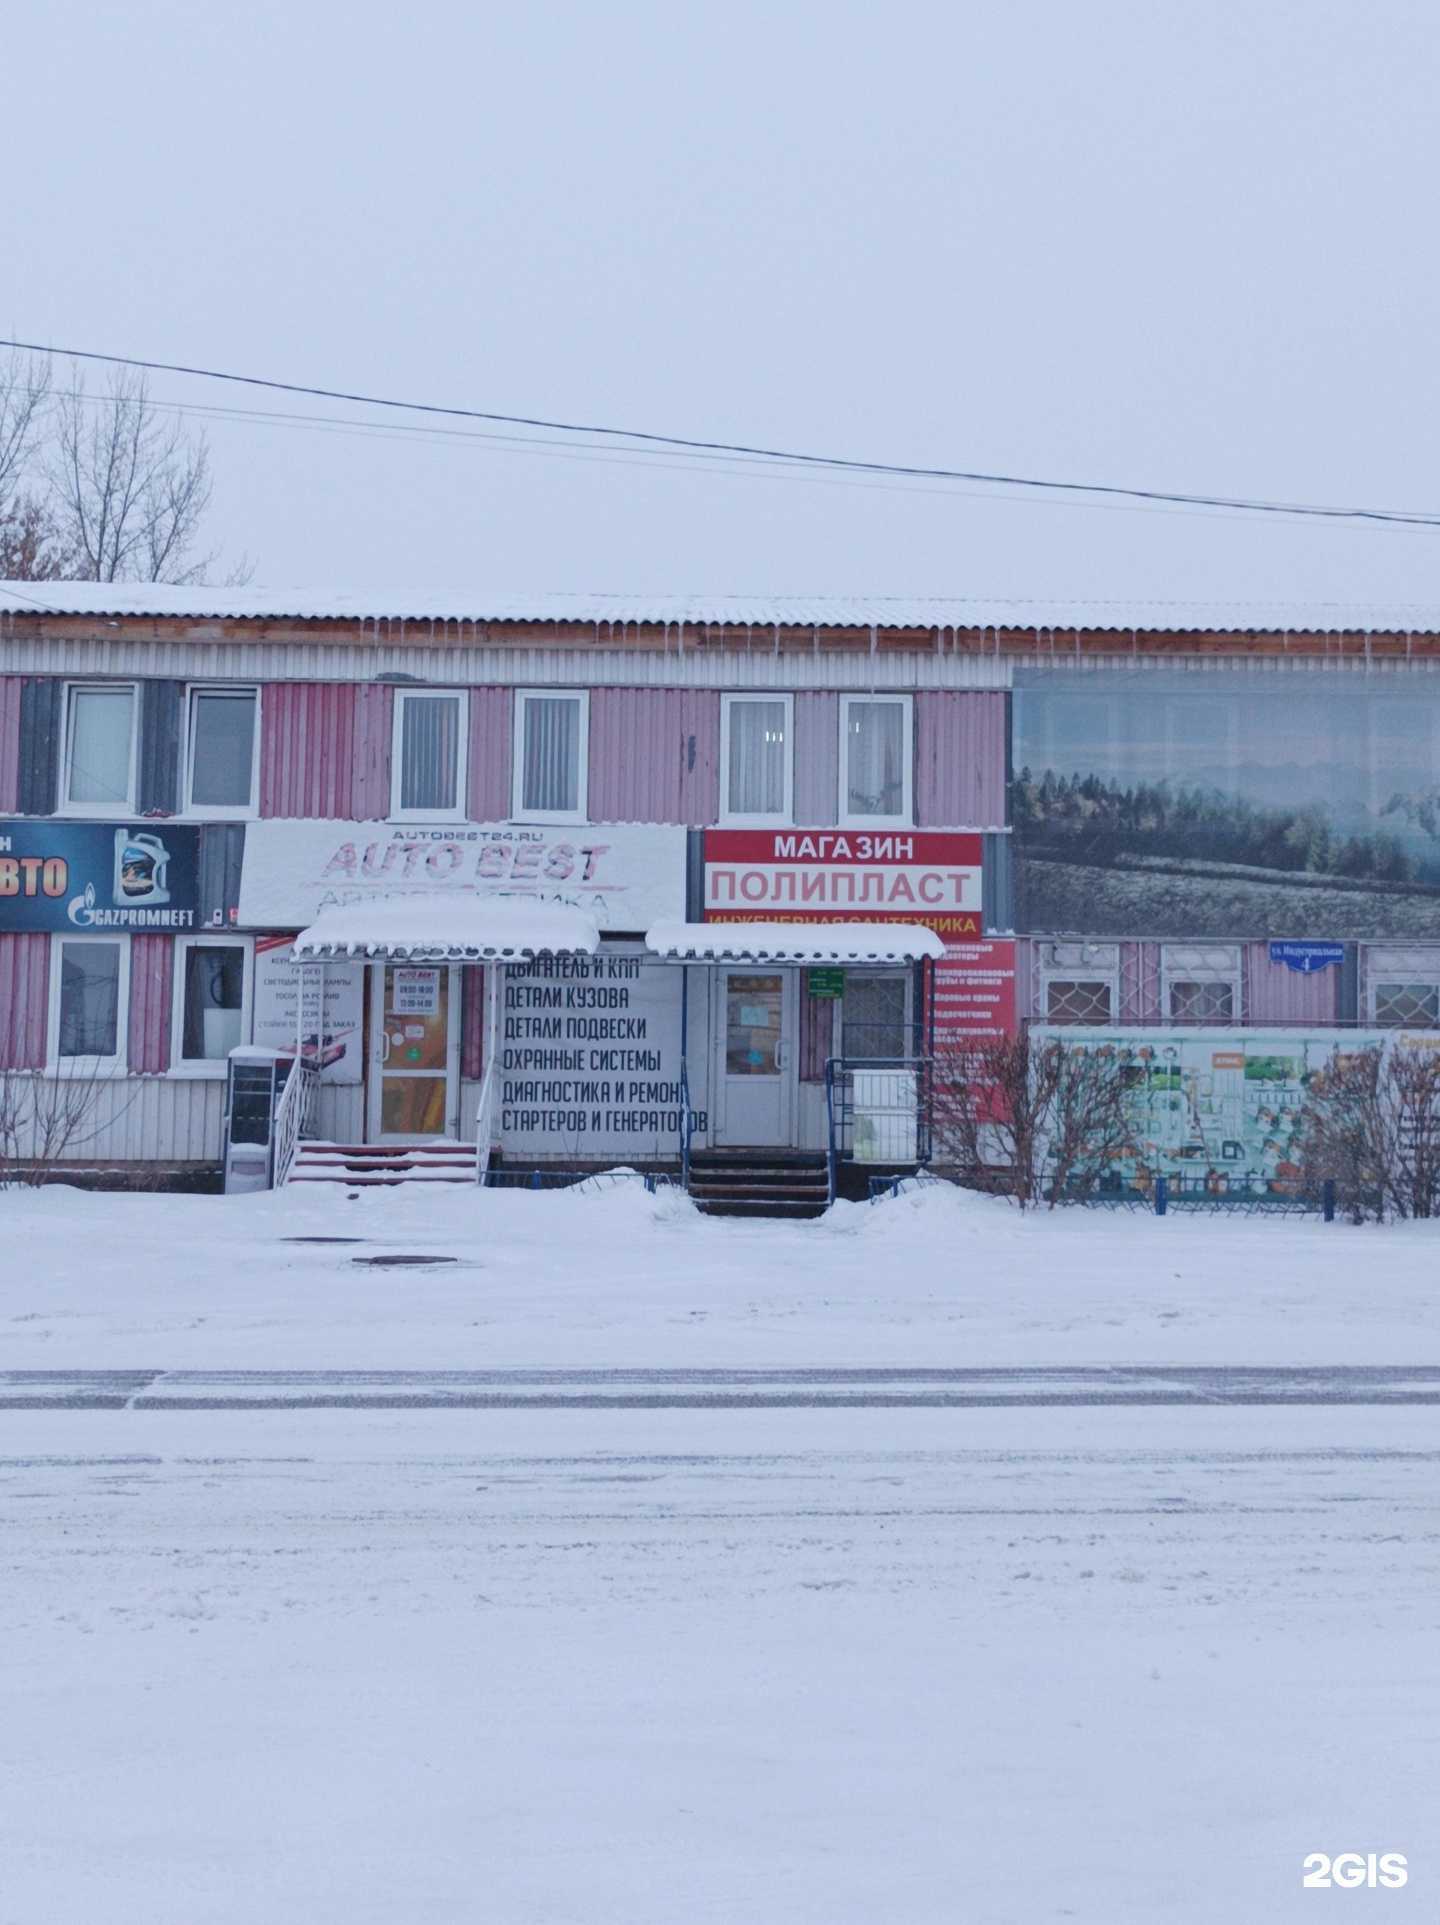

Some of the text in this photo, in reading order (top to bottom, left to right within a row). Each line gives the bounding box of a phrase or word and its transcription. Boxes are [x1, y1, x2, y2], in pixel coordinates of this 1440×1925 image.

[774, 835, 913, 860] МАГАЗИН
[321, 842, 611, 881] AUTO BEST
[711, 870, 971, 904] ПОЛИПЛАСТ
[94, 908, 195, 927] GAZPROMNEFT
[505, 957, 589, 980] ДВИГАТЕЛЬ
[608, 957, 640, 979] КПП
[504, 986, 629, 1010] ДЕТАЛИ КУЗОВА
[504, 1017, 647, 1041] ДЕТАЛИ ПОДВЕСКИ
[503, 1049, 661, 1072] ОХРАННЫЕ СИСТЕМЫ
[502, 1081, 610, 1105] ДИАГНОСТИКА
[615, 1082, 625, 1104] И
[502, 1109, 709, 1133] СТАРТЕРОВ И ГЕНЕРАТООВ
